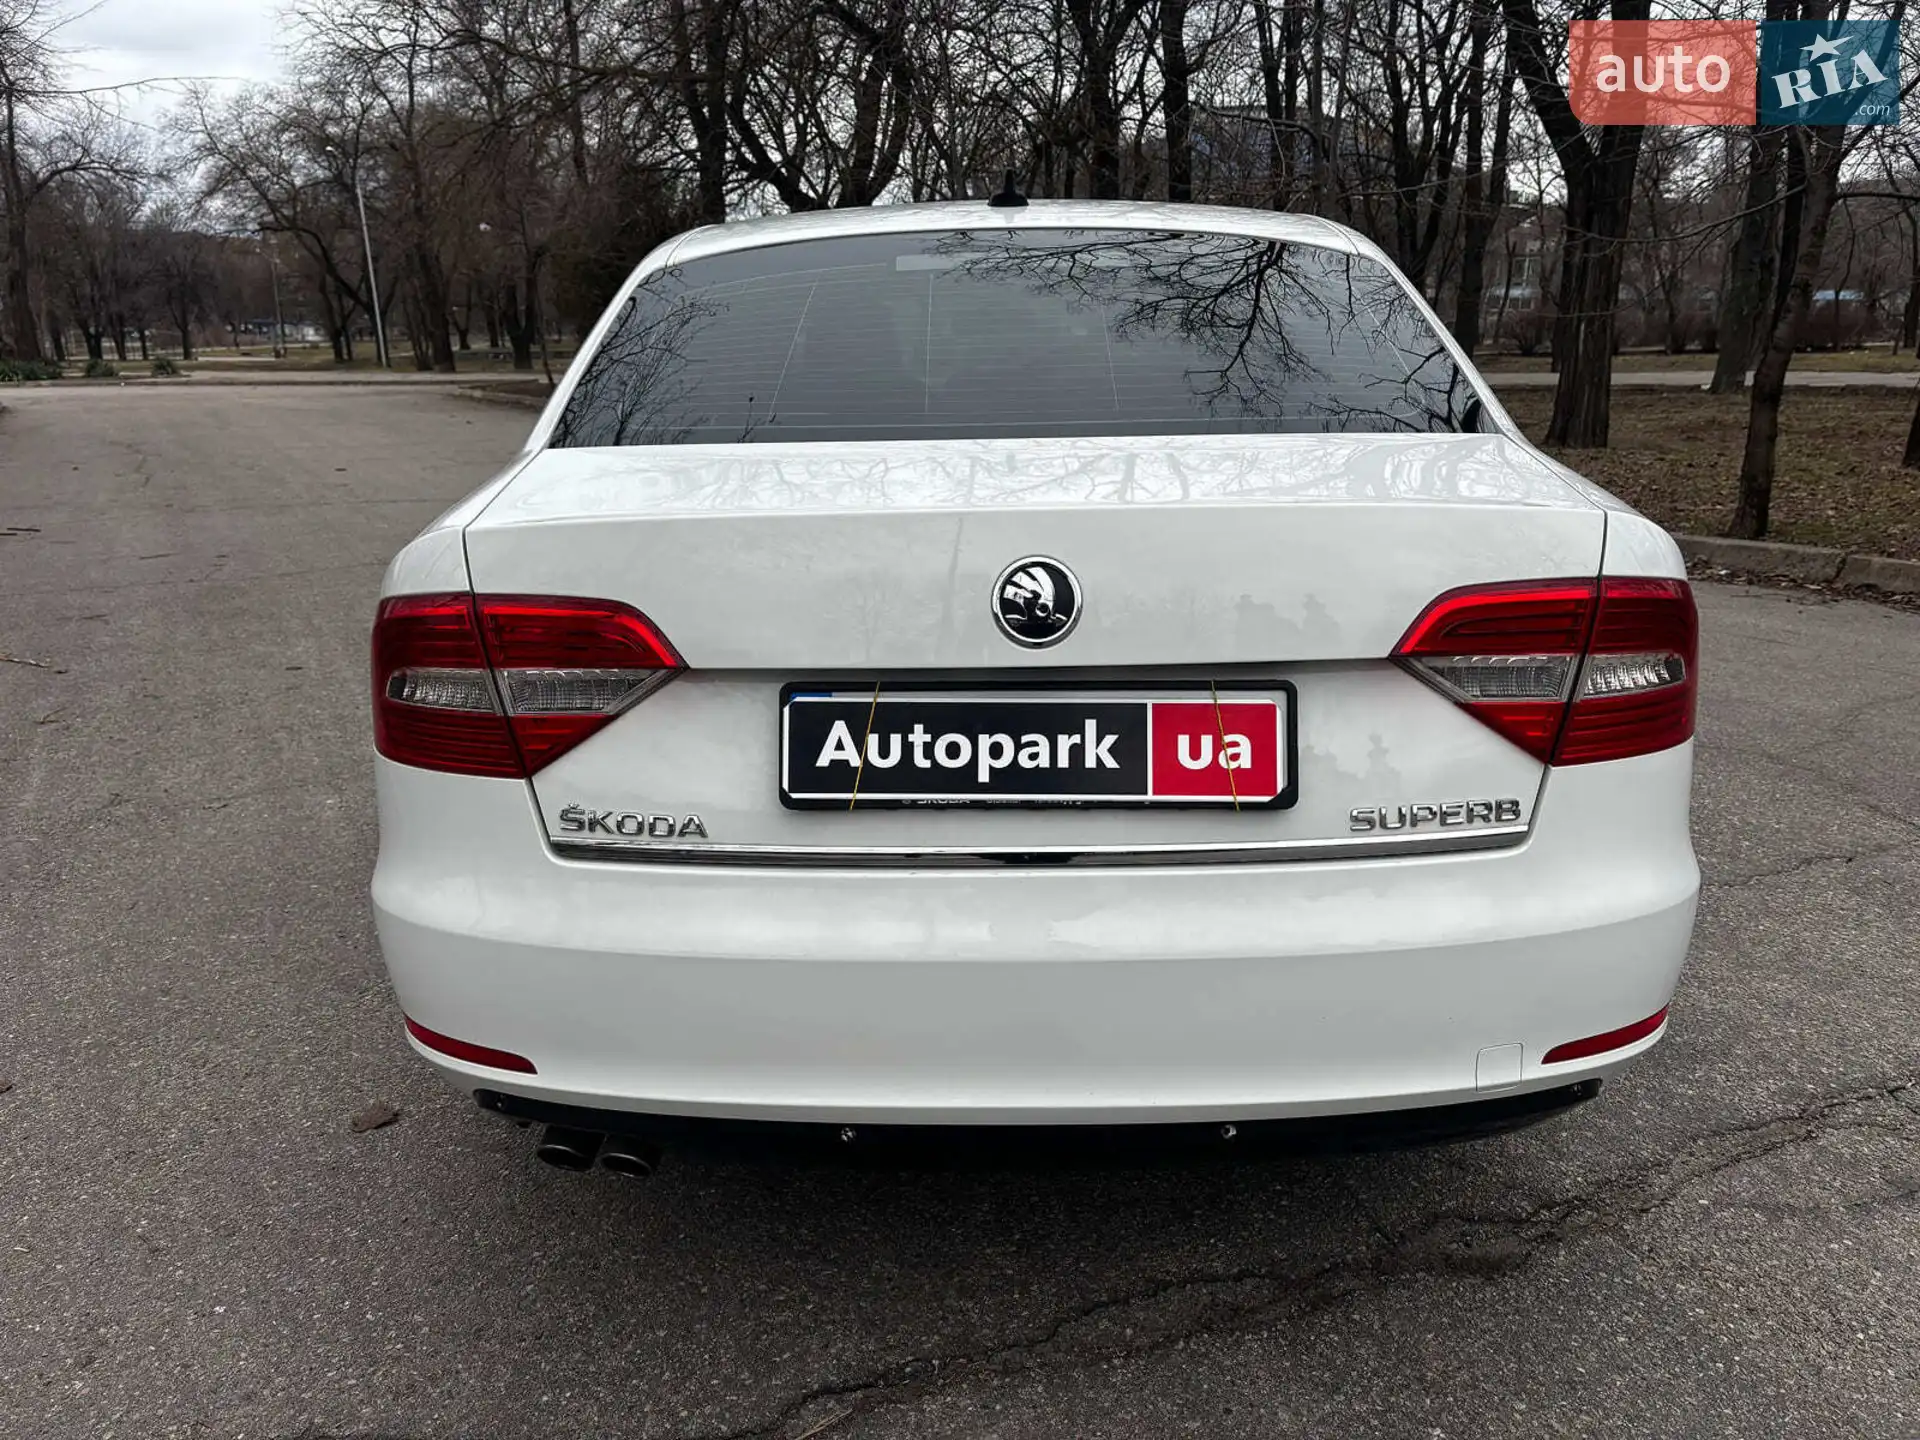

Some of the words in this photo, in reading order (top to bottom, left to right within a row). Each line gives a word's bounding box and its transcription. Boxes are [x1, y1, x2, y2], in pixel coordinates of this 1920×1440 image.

[815, 719, 1121, 783] Autopark
[1176, 733, 1253, 770] ua
[559, 800, 709, 838] ŠKODA
[1350, 798, 1522, 832] SUPERB
